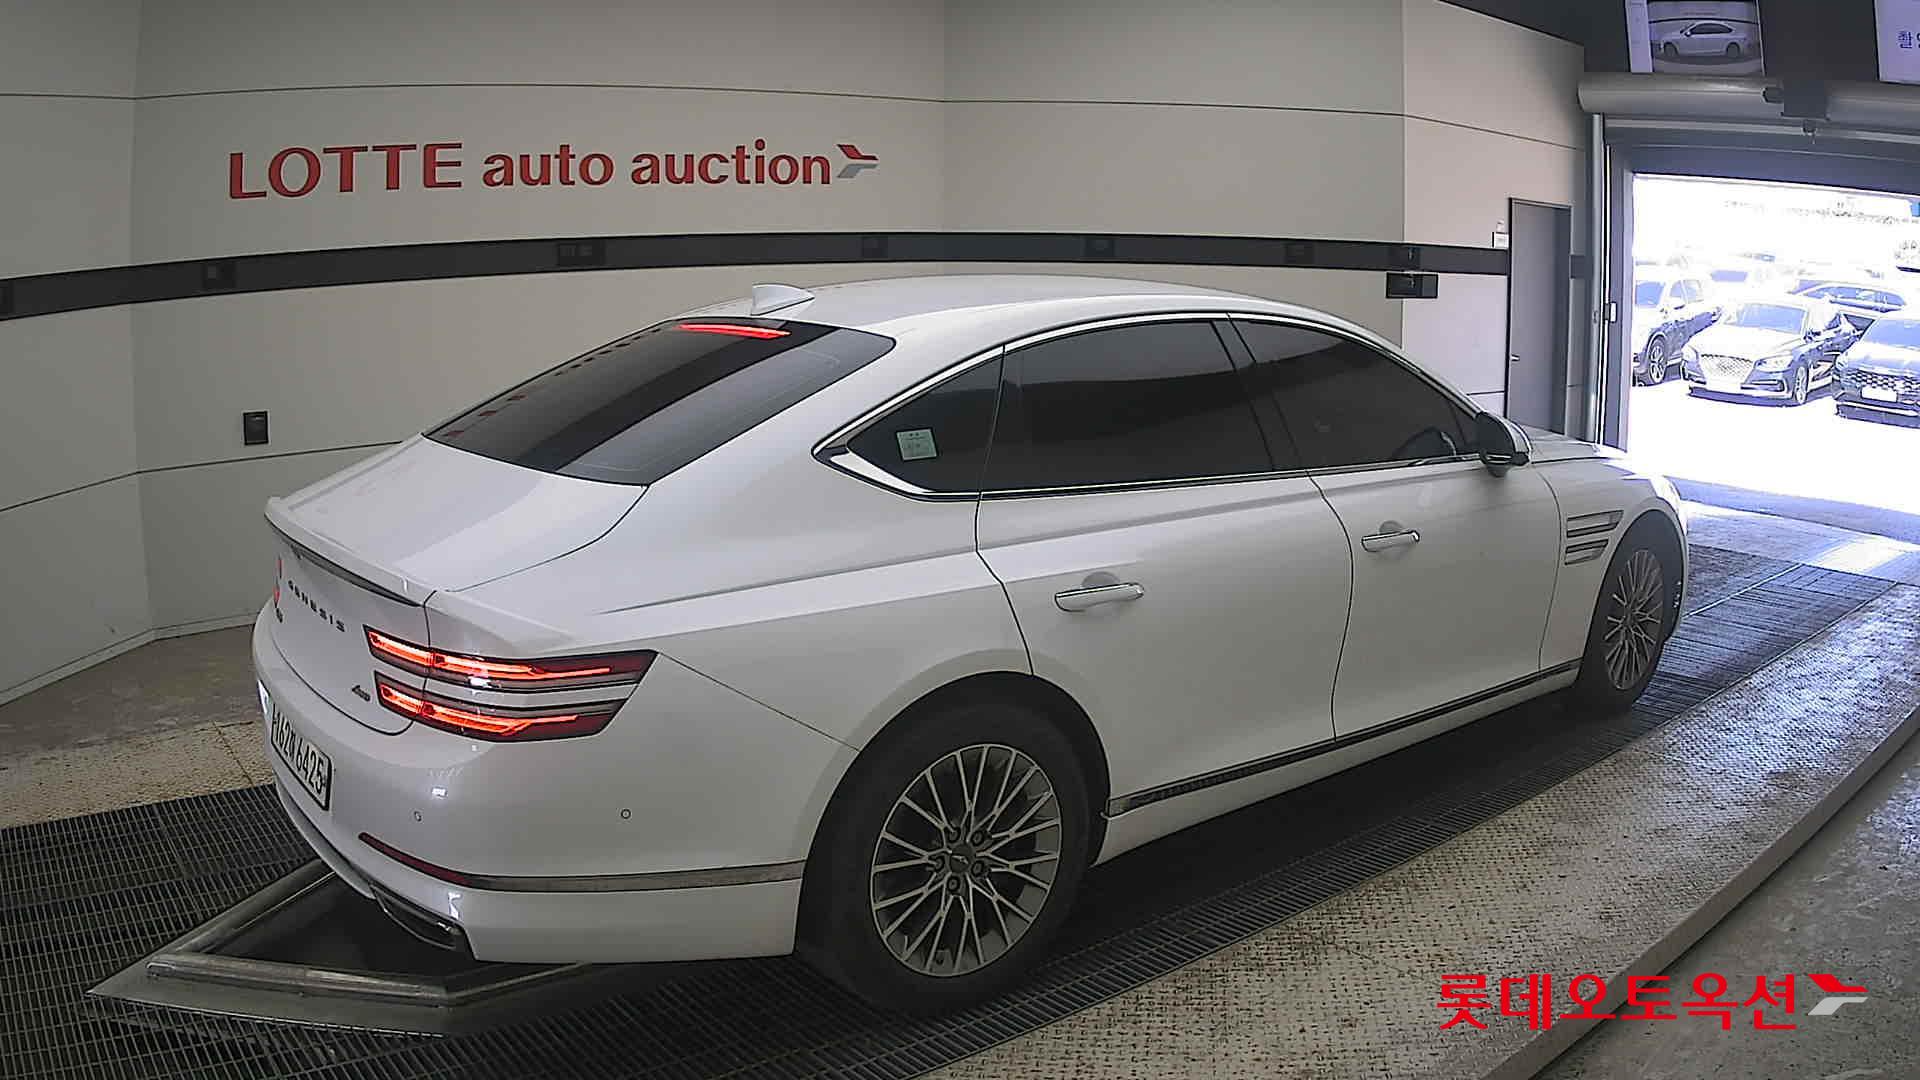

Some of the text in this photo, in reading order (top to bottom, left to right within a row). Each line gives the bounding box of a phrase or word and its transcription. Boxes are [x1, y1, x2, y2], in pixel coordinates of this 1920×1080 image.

[229, 140, 831, 199] LOTTE auto auction
